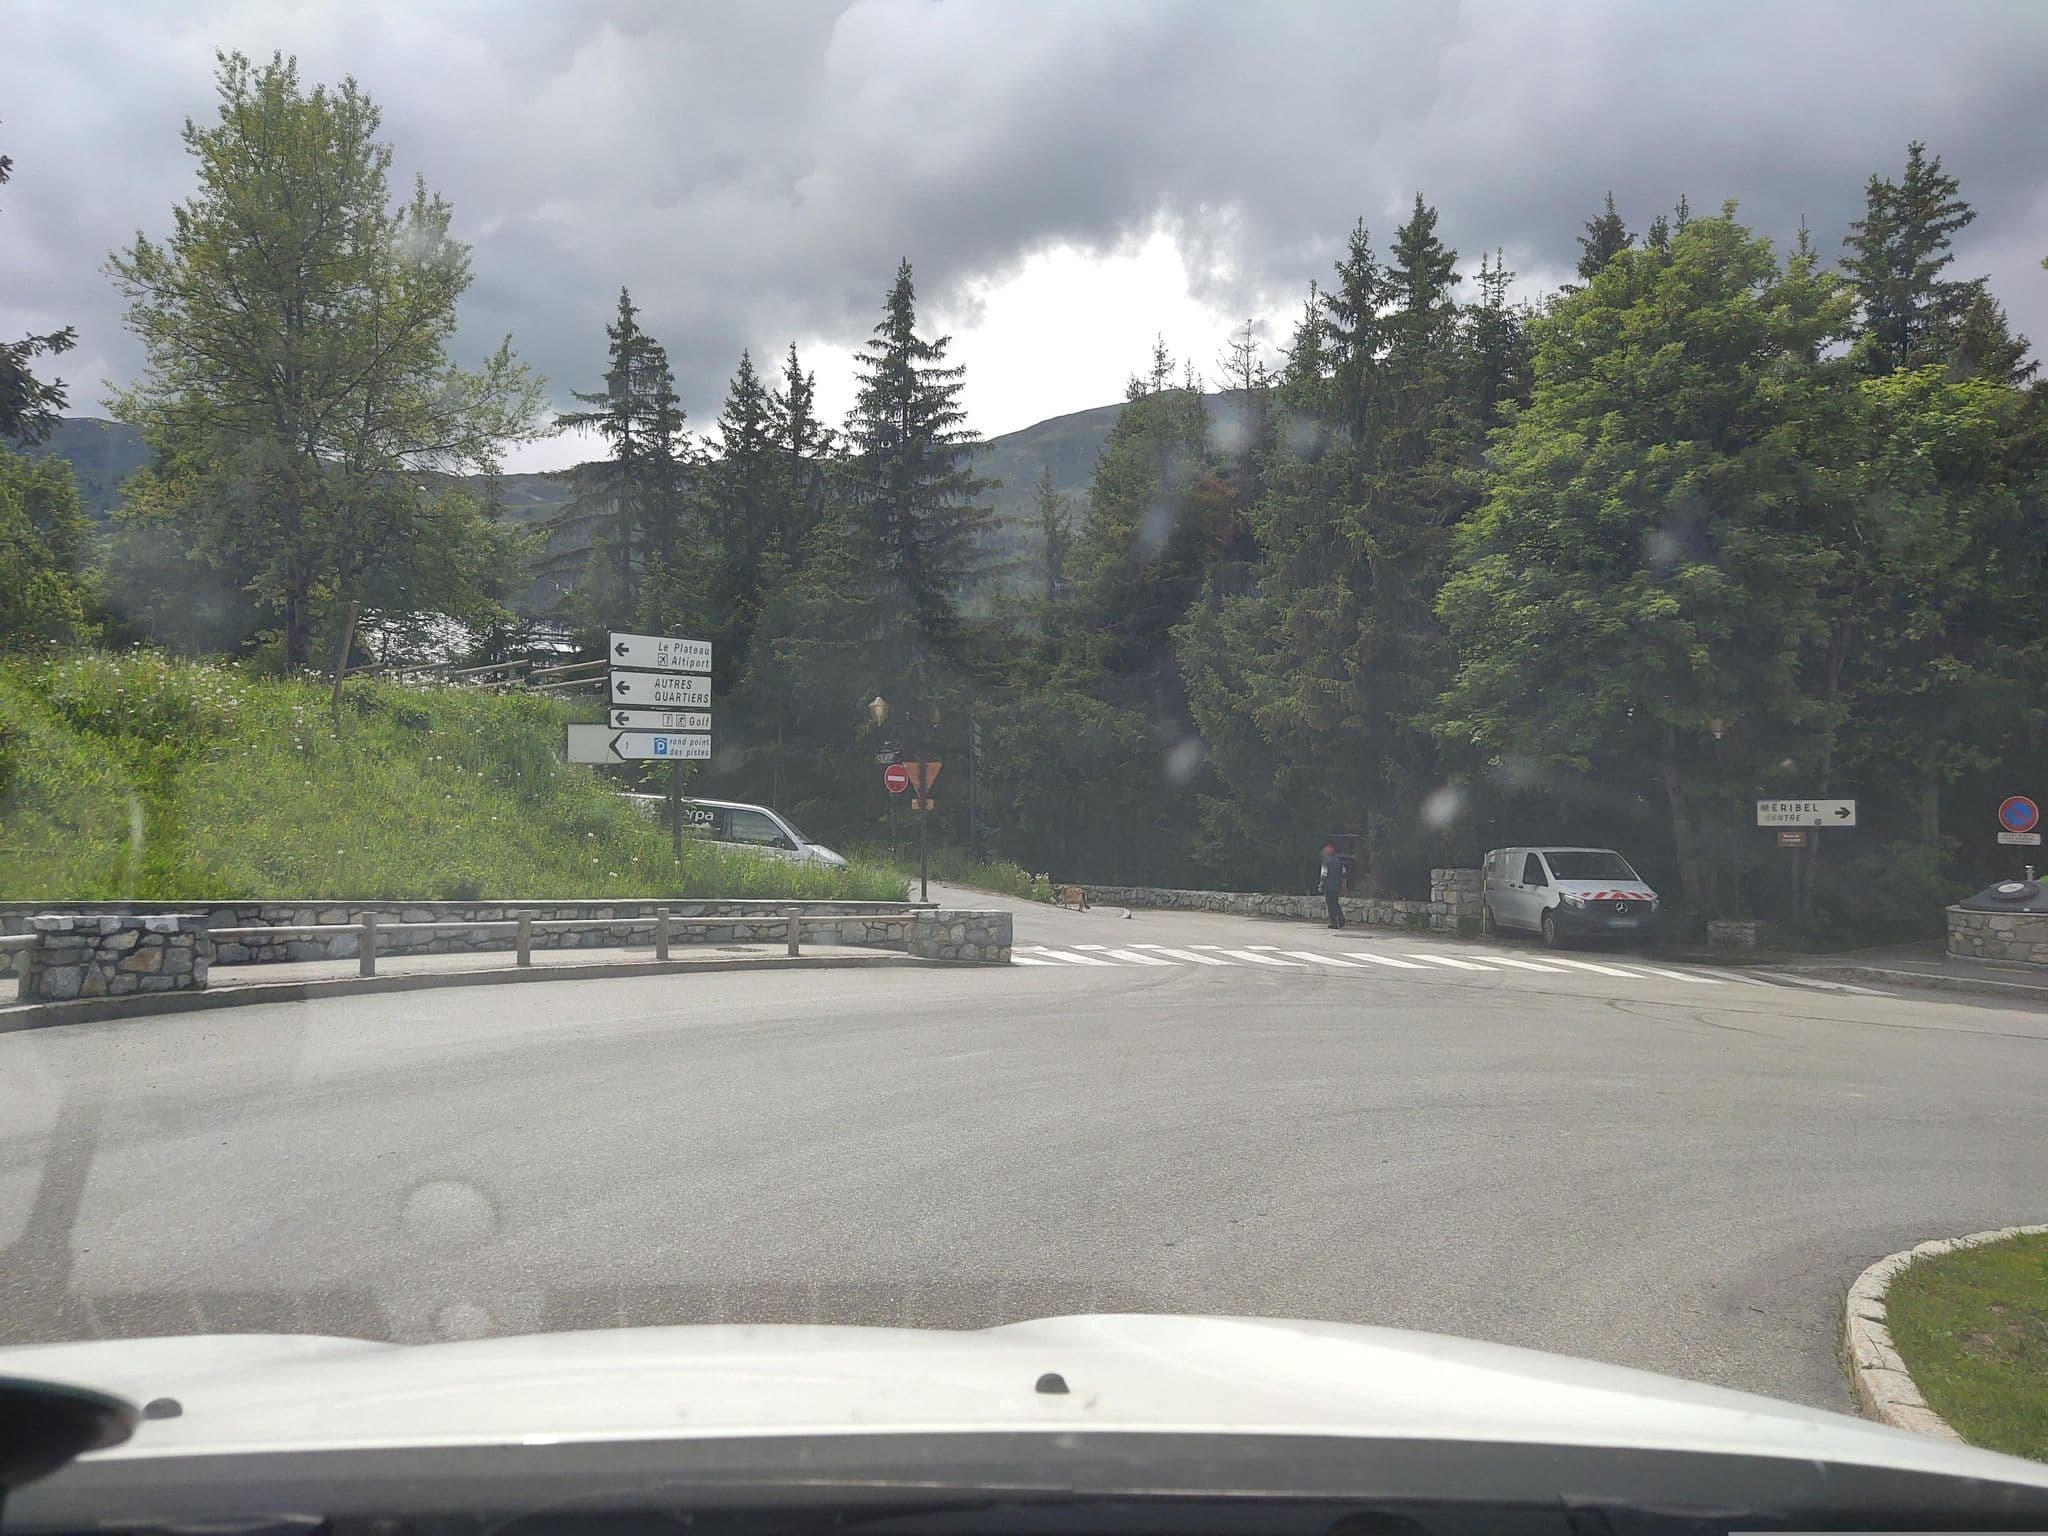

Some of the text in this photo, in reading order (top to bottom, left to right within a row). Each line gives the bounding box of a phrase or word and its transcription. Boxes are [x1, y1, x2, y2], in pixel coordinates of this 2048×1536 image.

[658, 641, 710, 656] Le Plateau
[671, 655, 710, 669] Altiport
[654, 678, 692, 690] AUTRES
[654, 691, 709, 704] QUARTIERS
[689, 716, 710, 727] Golf
[669, 737, 710, 748] rond point
[669, 747, 710, 758] des pistes
[1760, 803, 1819, 812] MERIBEL
